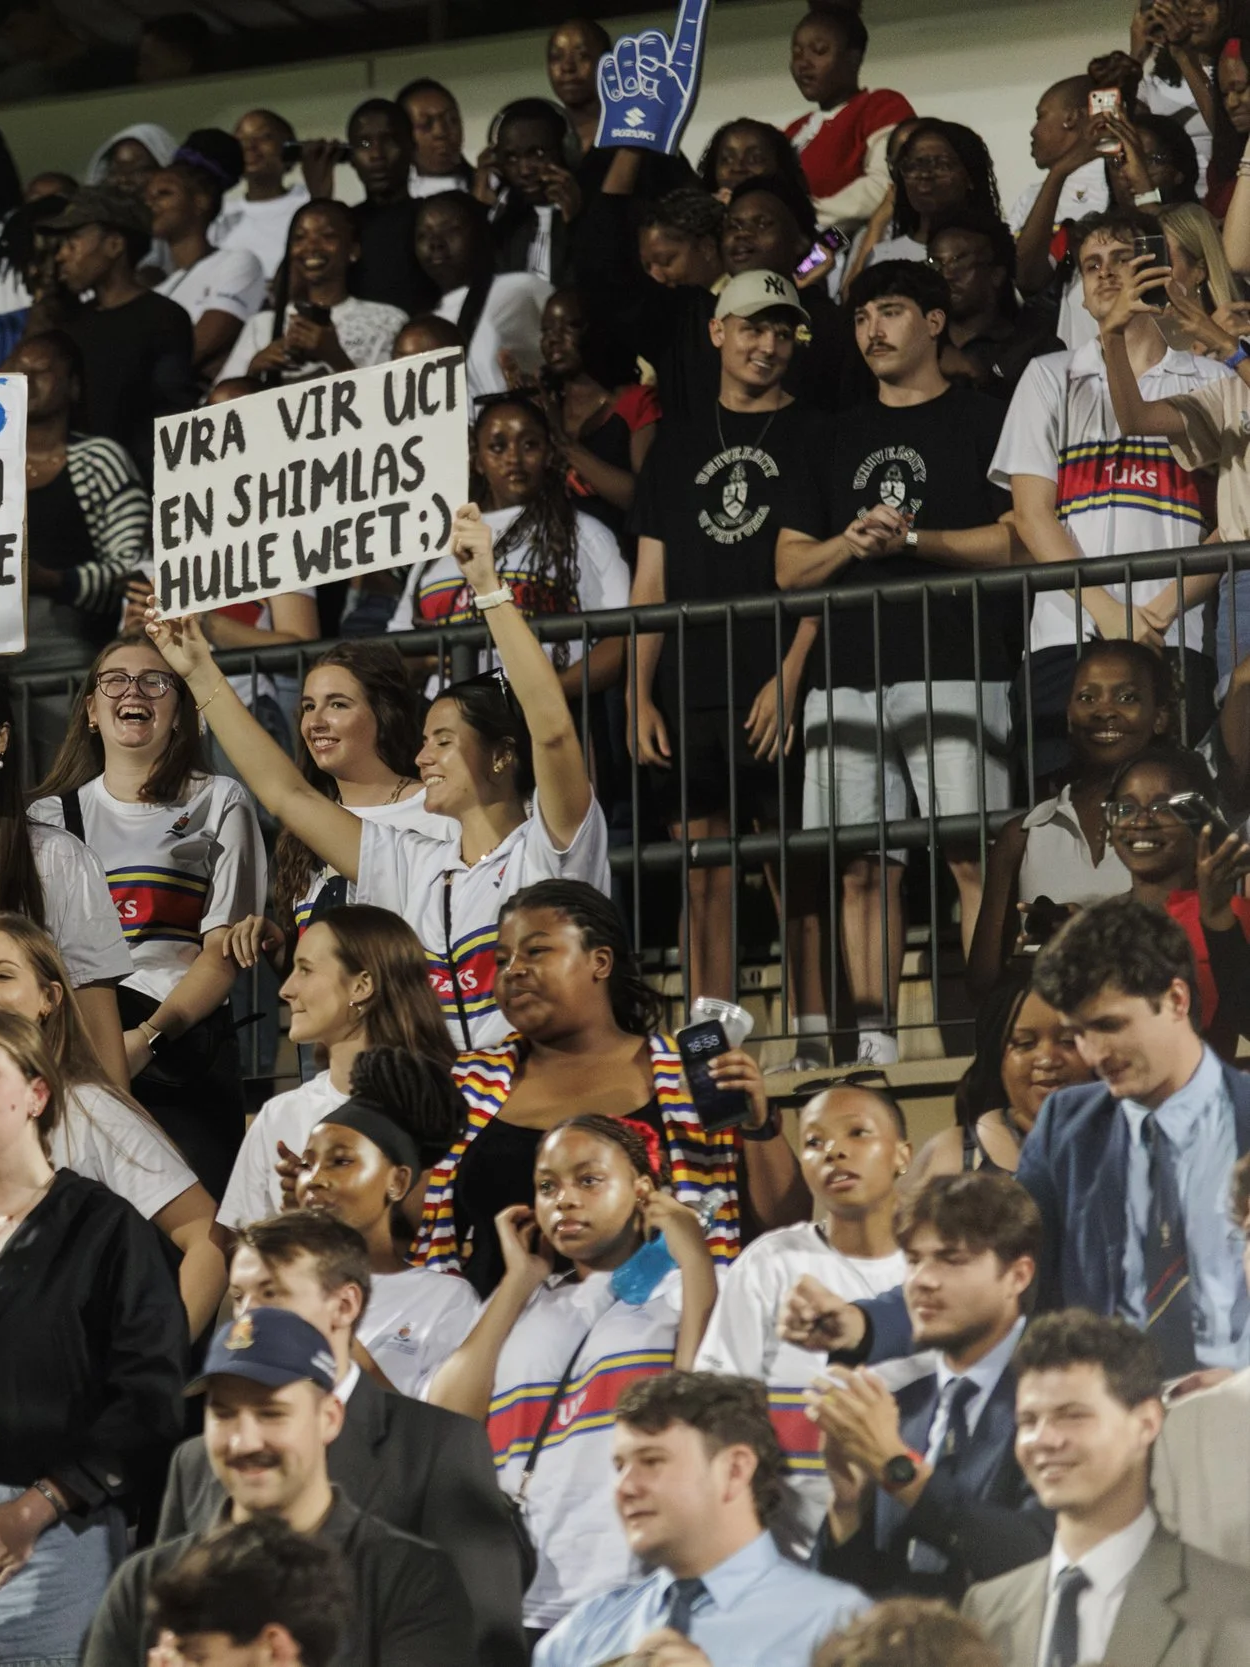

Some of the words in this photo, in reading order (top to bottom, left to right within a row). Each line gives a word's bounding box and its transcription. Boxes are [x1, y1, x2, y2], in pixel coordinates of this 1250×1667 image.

[764, 275, 786, 296] NY
[159, 409, 246, 471] VRA
[277, 380, 362, 442] VIR
[384, 353, 465, 427] UCT
[694, 445, 780, 485] UNIVERSITY
[852, 445, 927, 490] UNIVERSITY
[1105, 462, 1158, 488] Tuks
[159, 487, 214, 550] EN
[227, 435, 425, 528] SHIMLAS
[159, 532, 281, 612] HULLE
[293, 501, 410, 581] WEET
